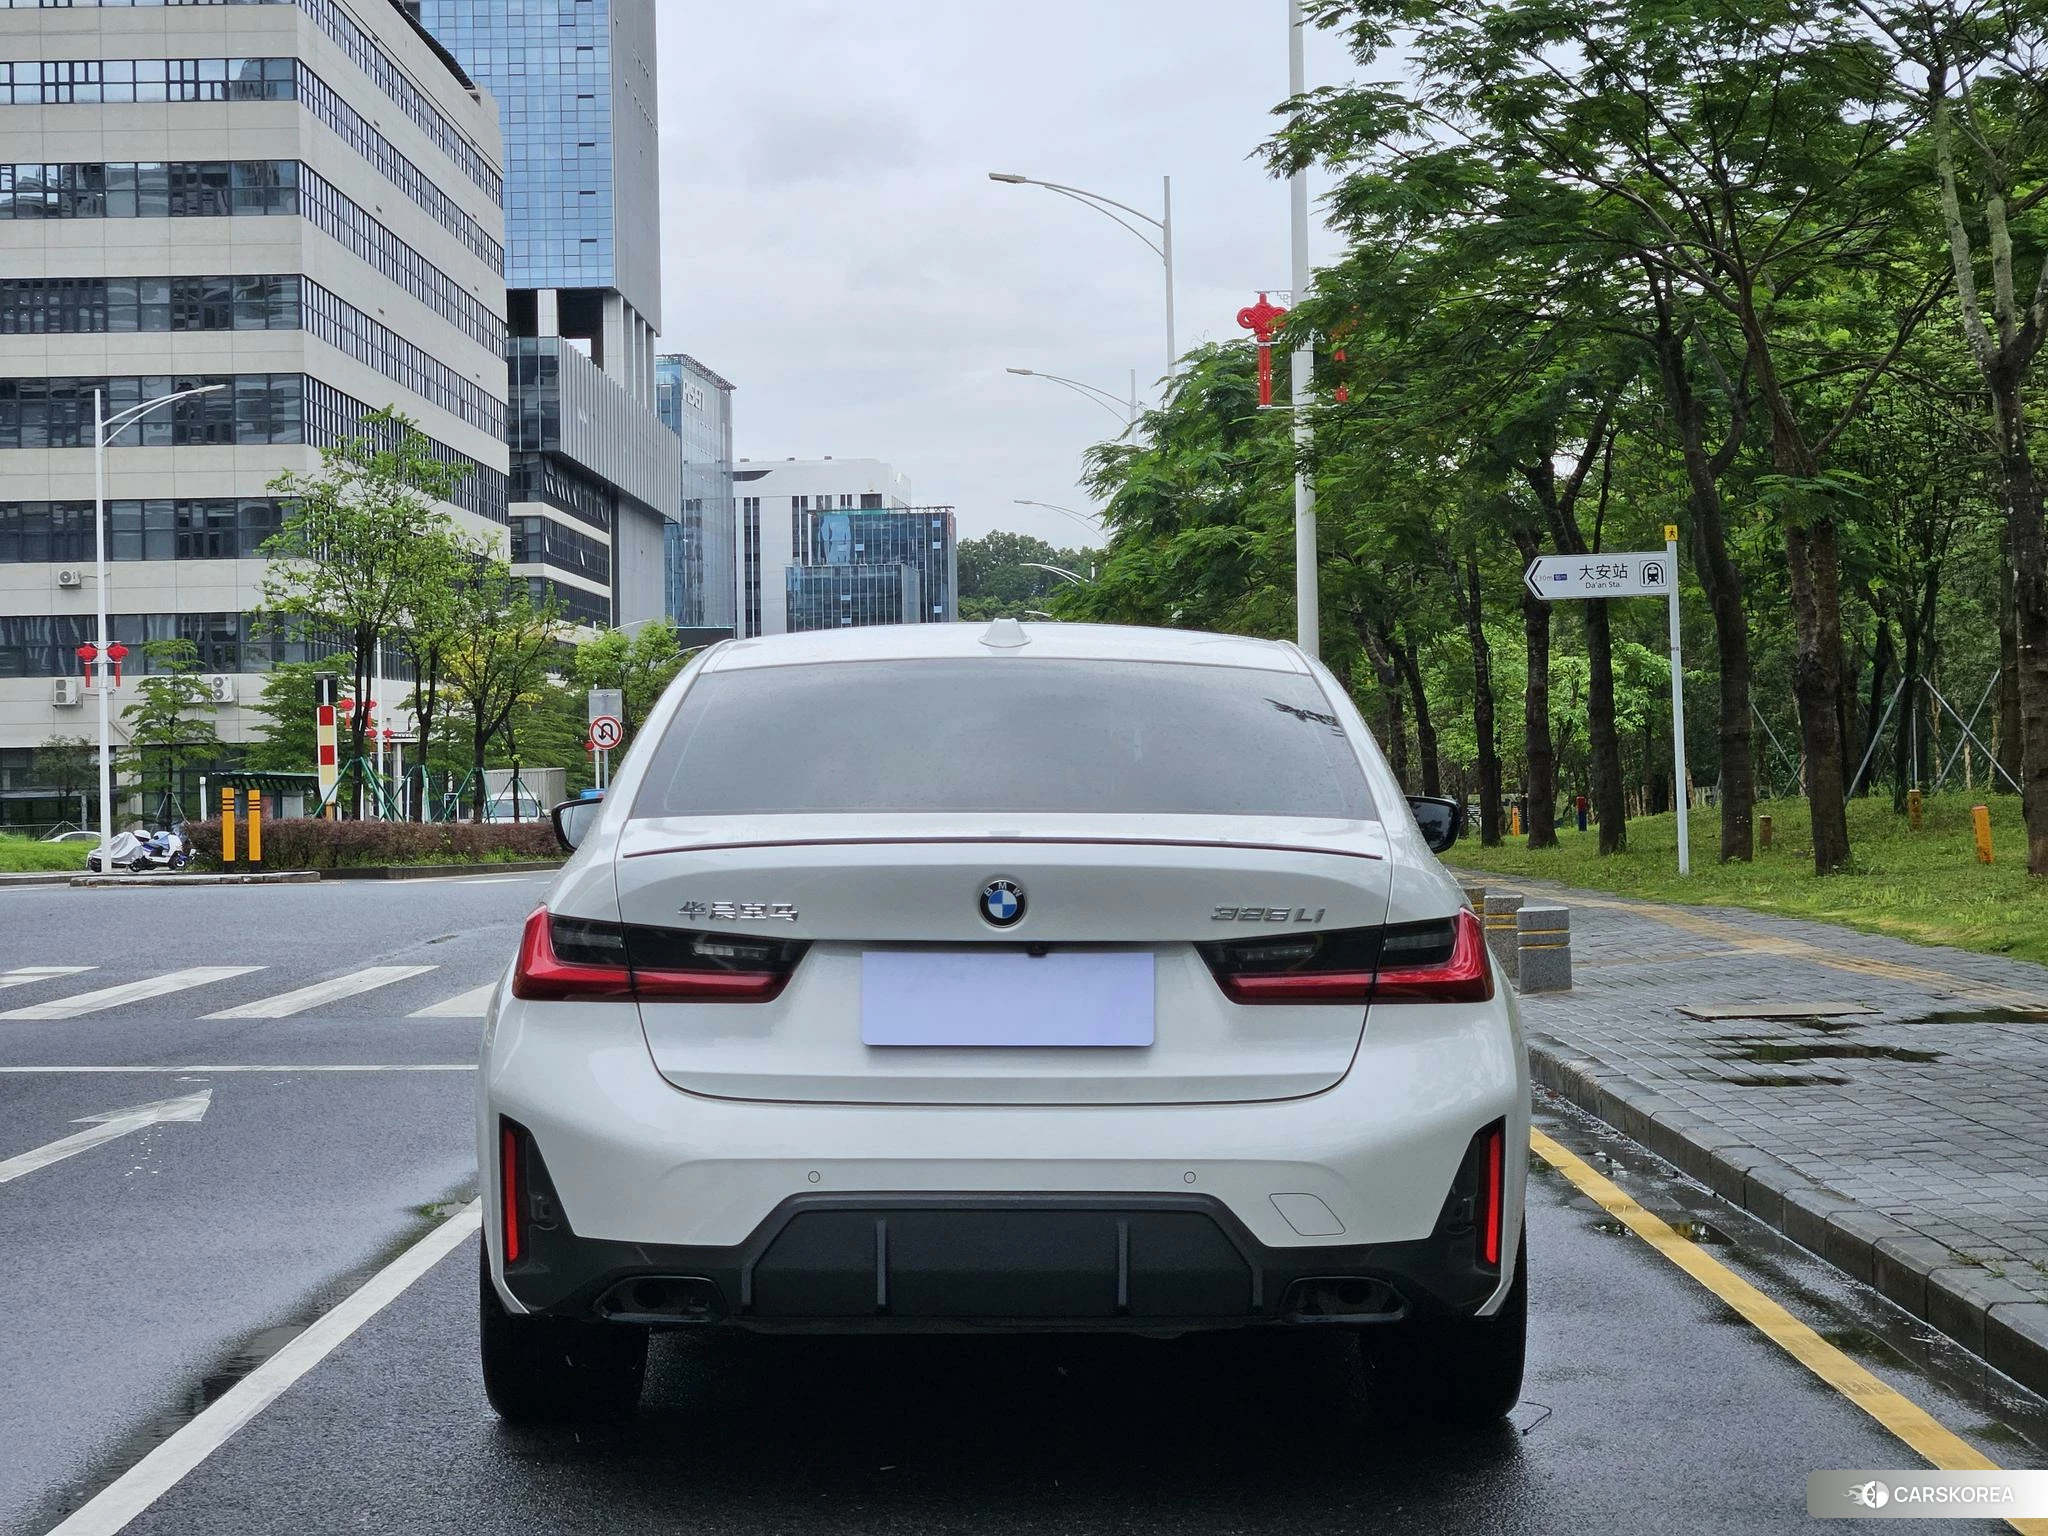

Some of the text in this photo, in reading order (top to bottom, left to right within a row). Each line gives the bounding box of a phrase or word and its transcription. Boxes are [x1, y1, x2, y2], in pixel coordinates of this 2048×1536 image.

[1579, 563, 1628, 580] 大安站
[1586, 580, 1623, 589] Da'an Sta.
[984, 882, 1023, 897] BMW
[677, 901, 799, 921] 华晨宝马
